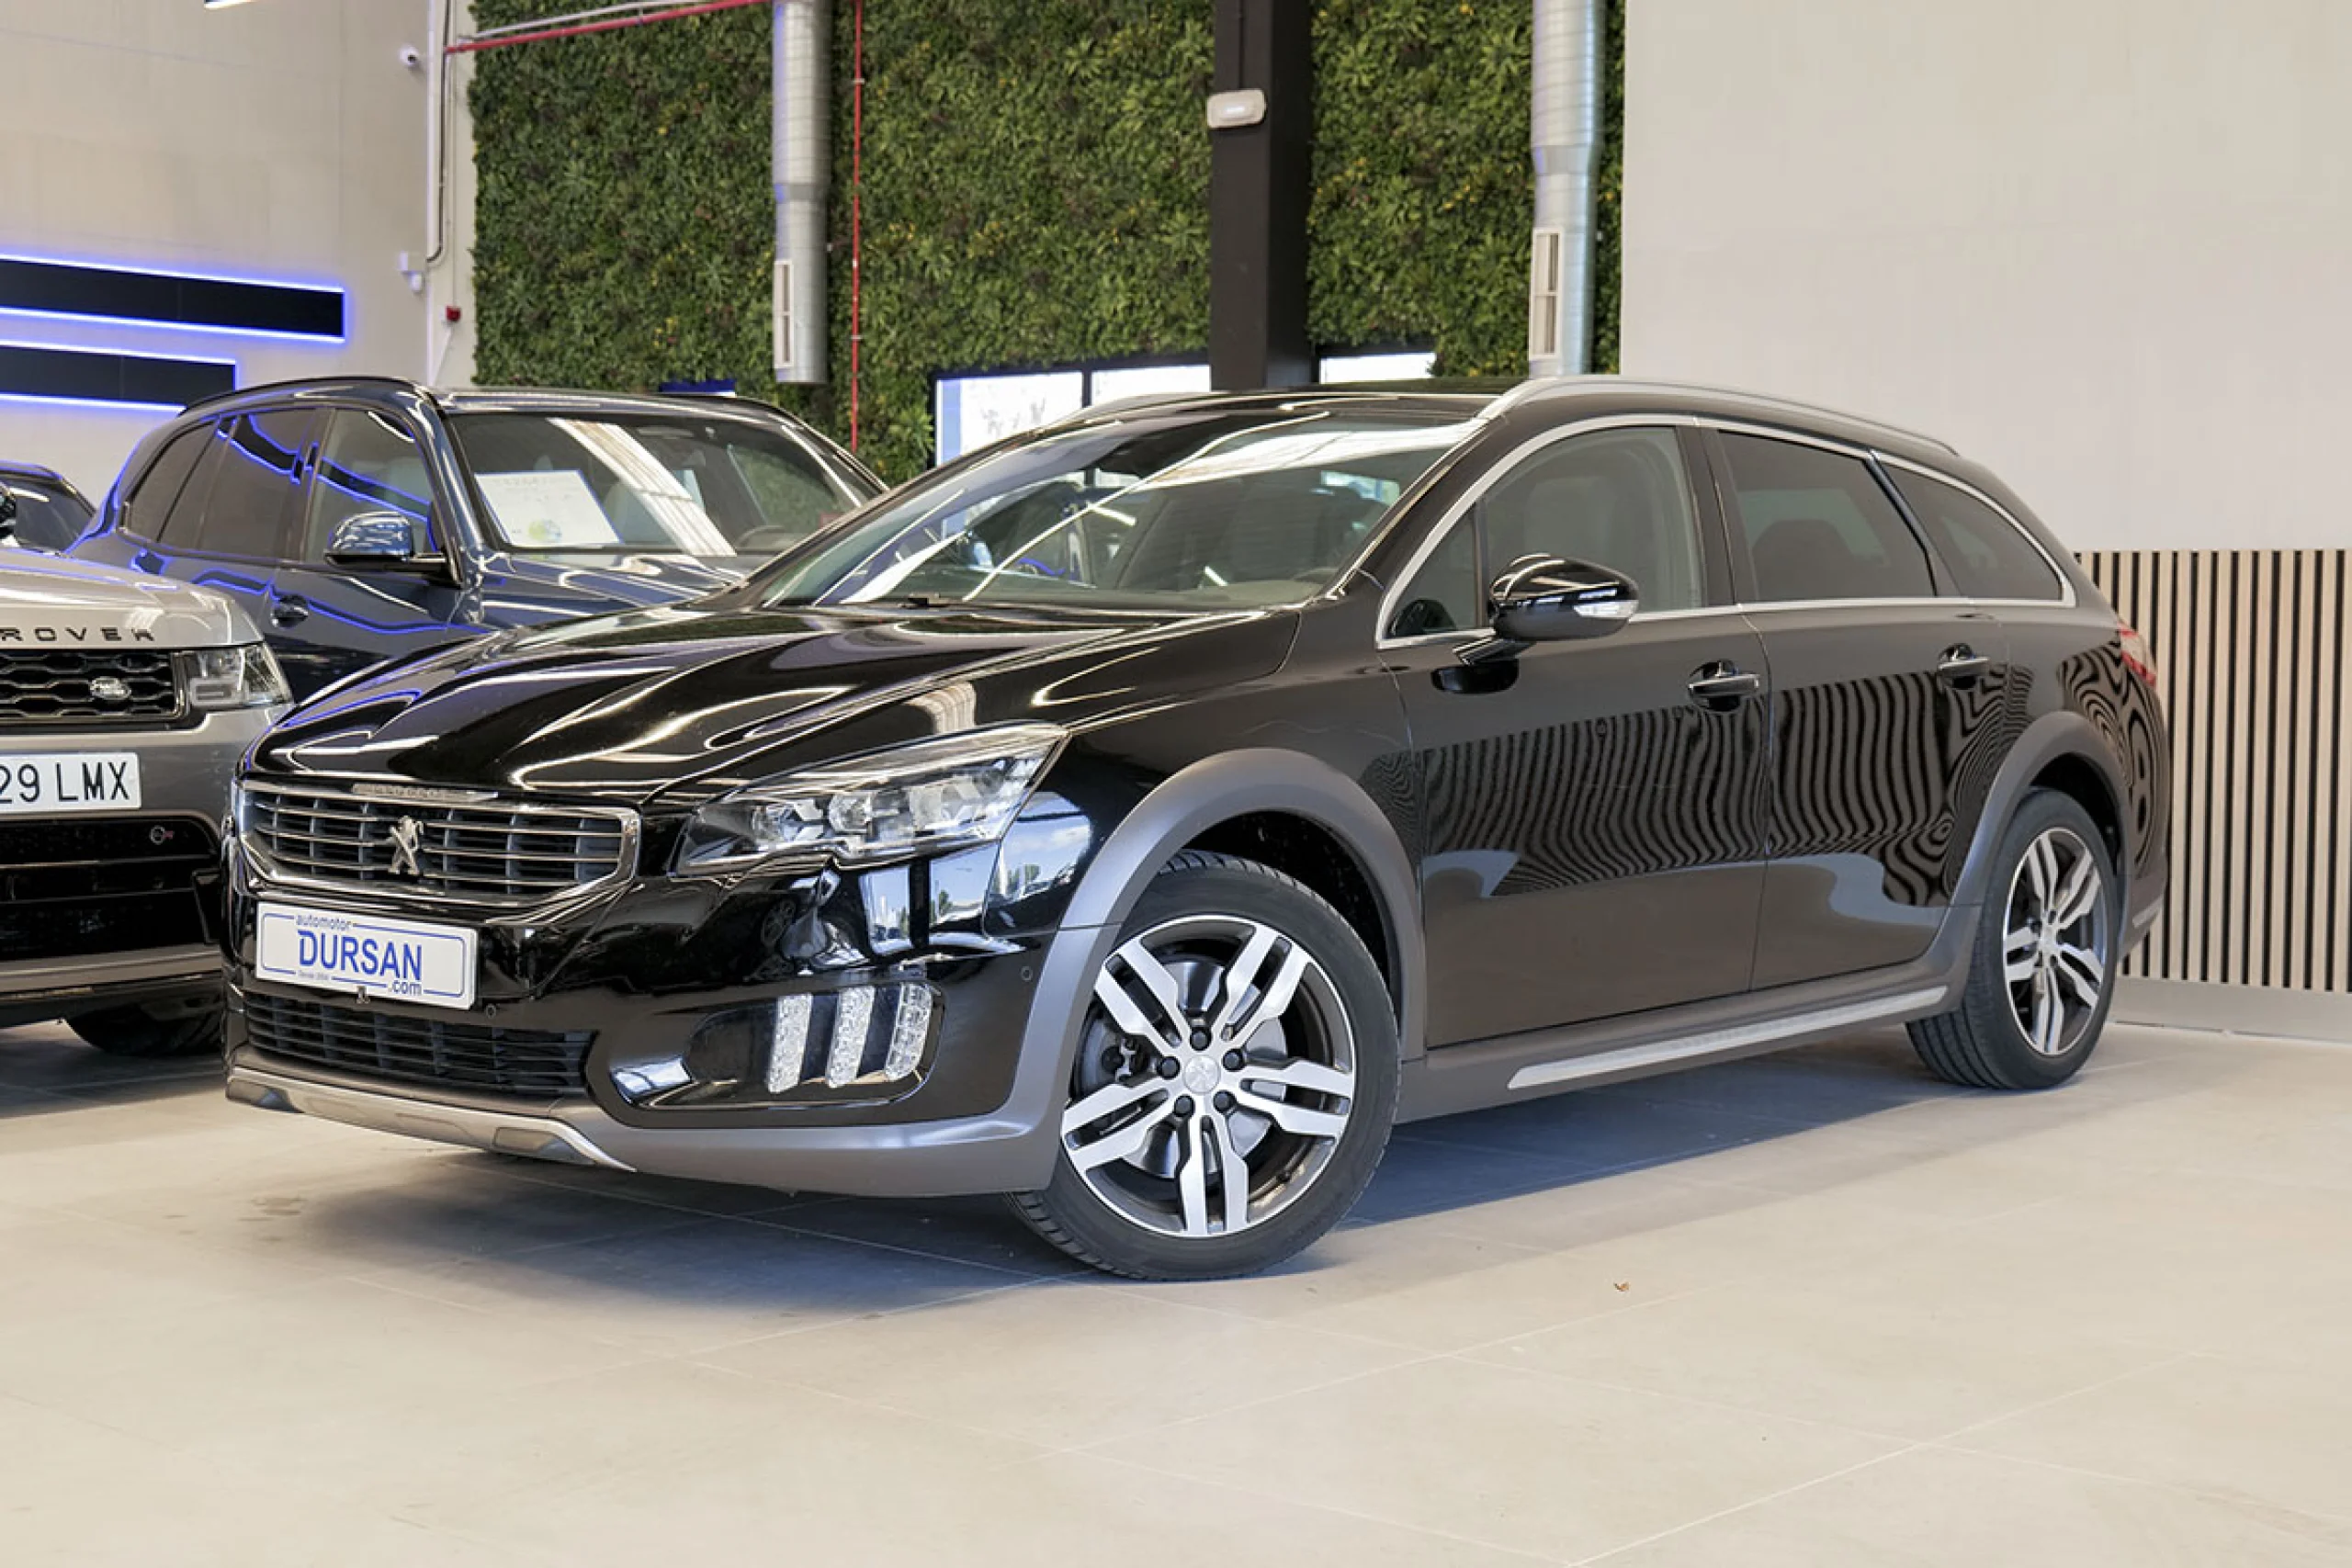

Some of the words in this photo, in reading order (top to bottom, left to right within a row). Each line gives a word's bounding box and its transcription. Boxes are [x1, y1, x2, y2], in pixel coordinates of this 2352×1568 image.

[55, 761, 130, 801] LMX
[296, 914, 352, 931] automotor
[297, 929, 423, 980] DURSAN
